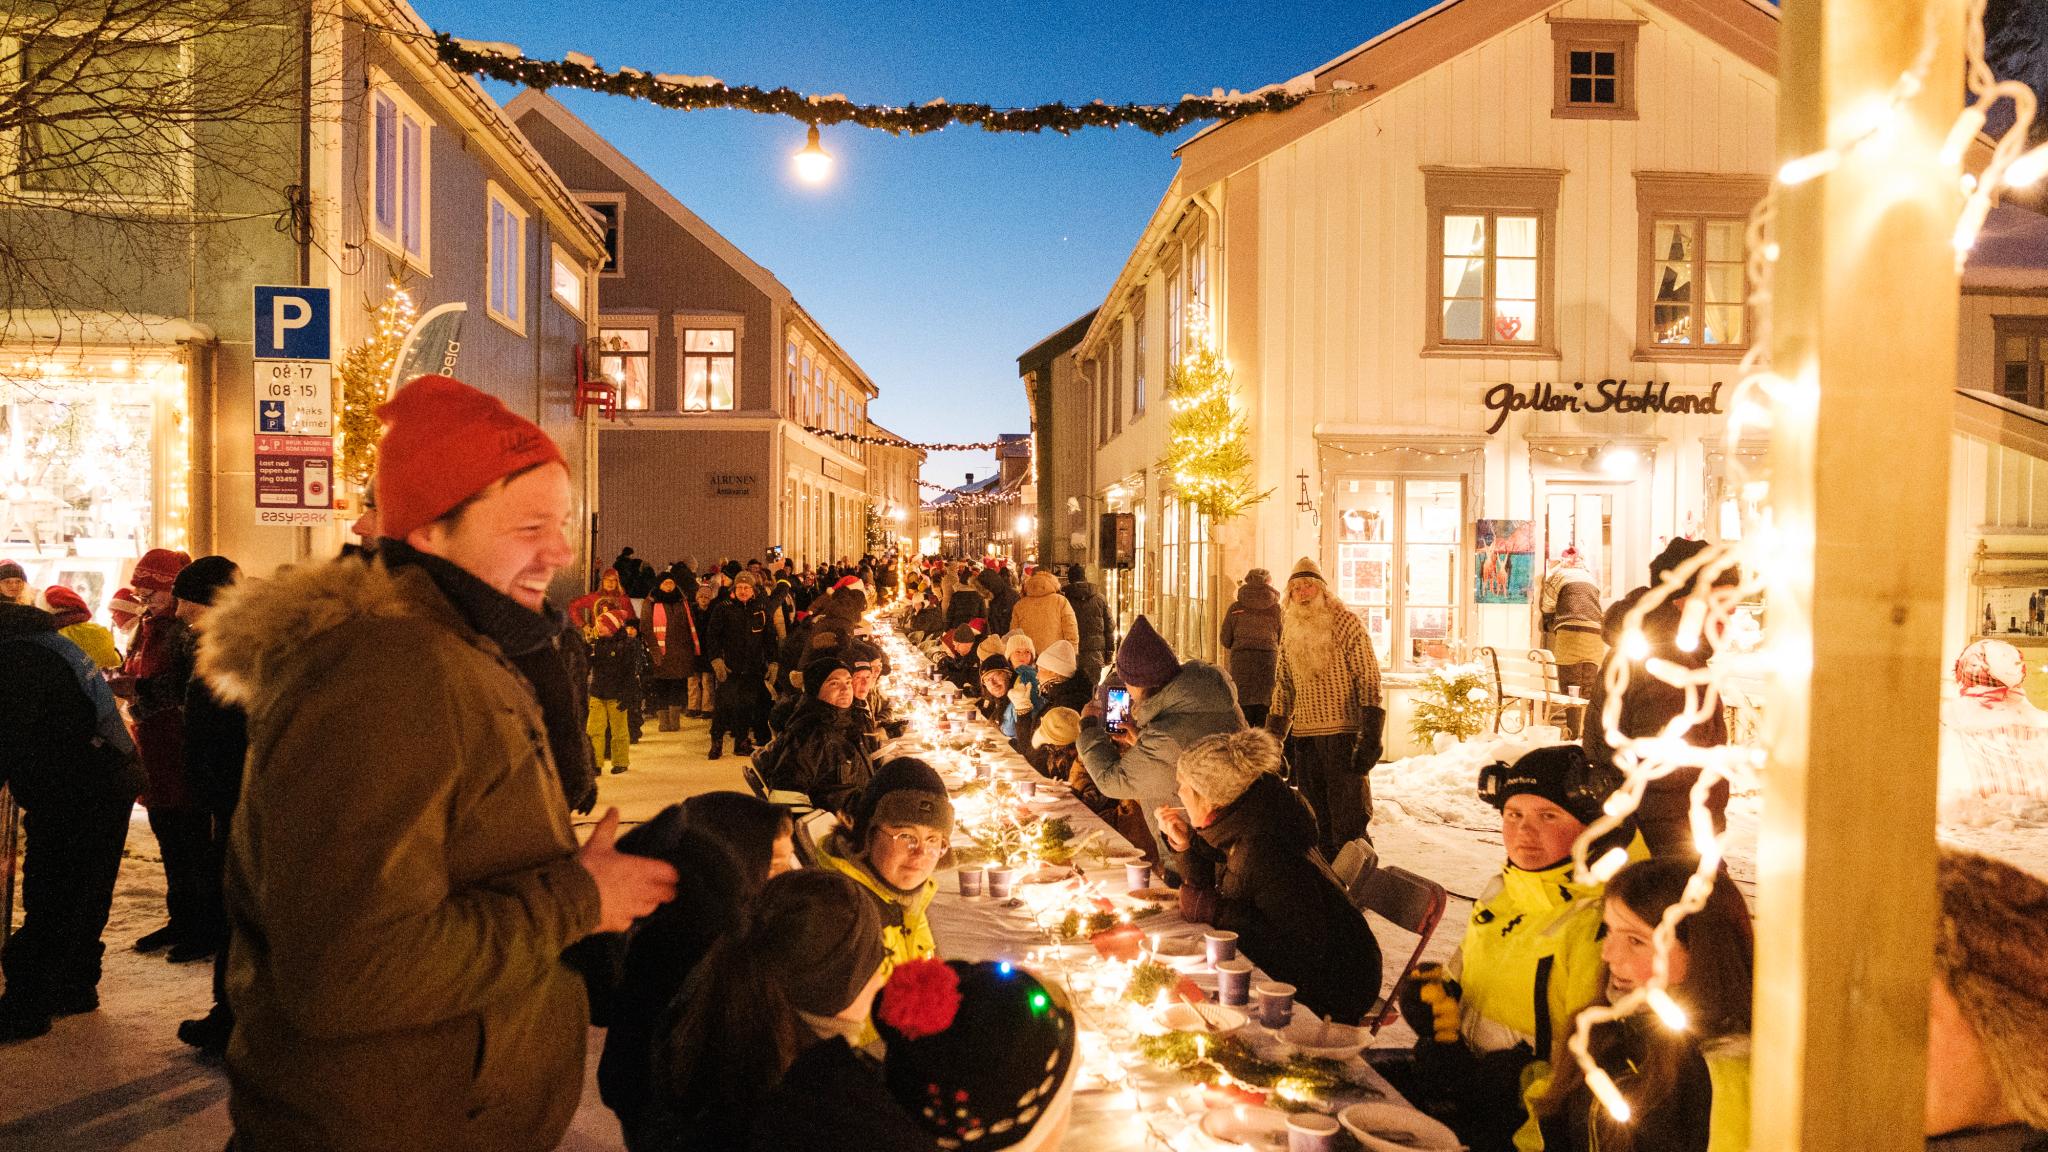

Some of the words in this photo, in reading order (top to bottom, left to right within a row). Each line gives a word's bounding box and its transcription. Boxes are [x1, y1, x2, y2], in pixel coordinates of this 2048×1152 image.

[273, 295, 312, 350] P
[1584, 379, 1723, 414] Stokland
[301, 420, 328, 428] timer
[259, 475, 274, 483] ring
